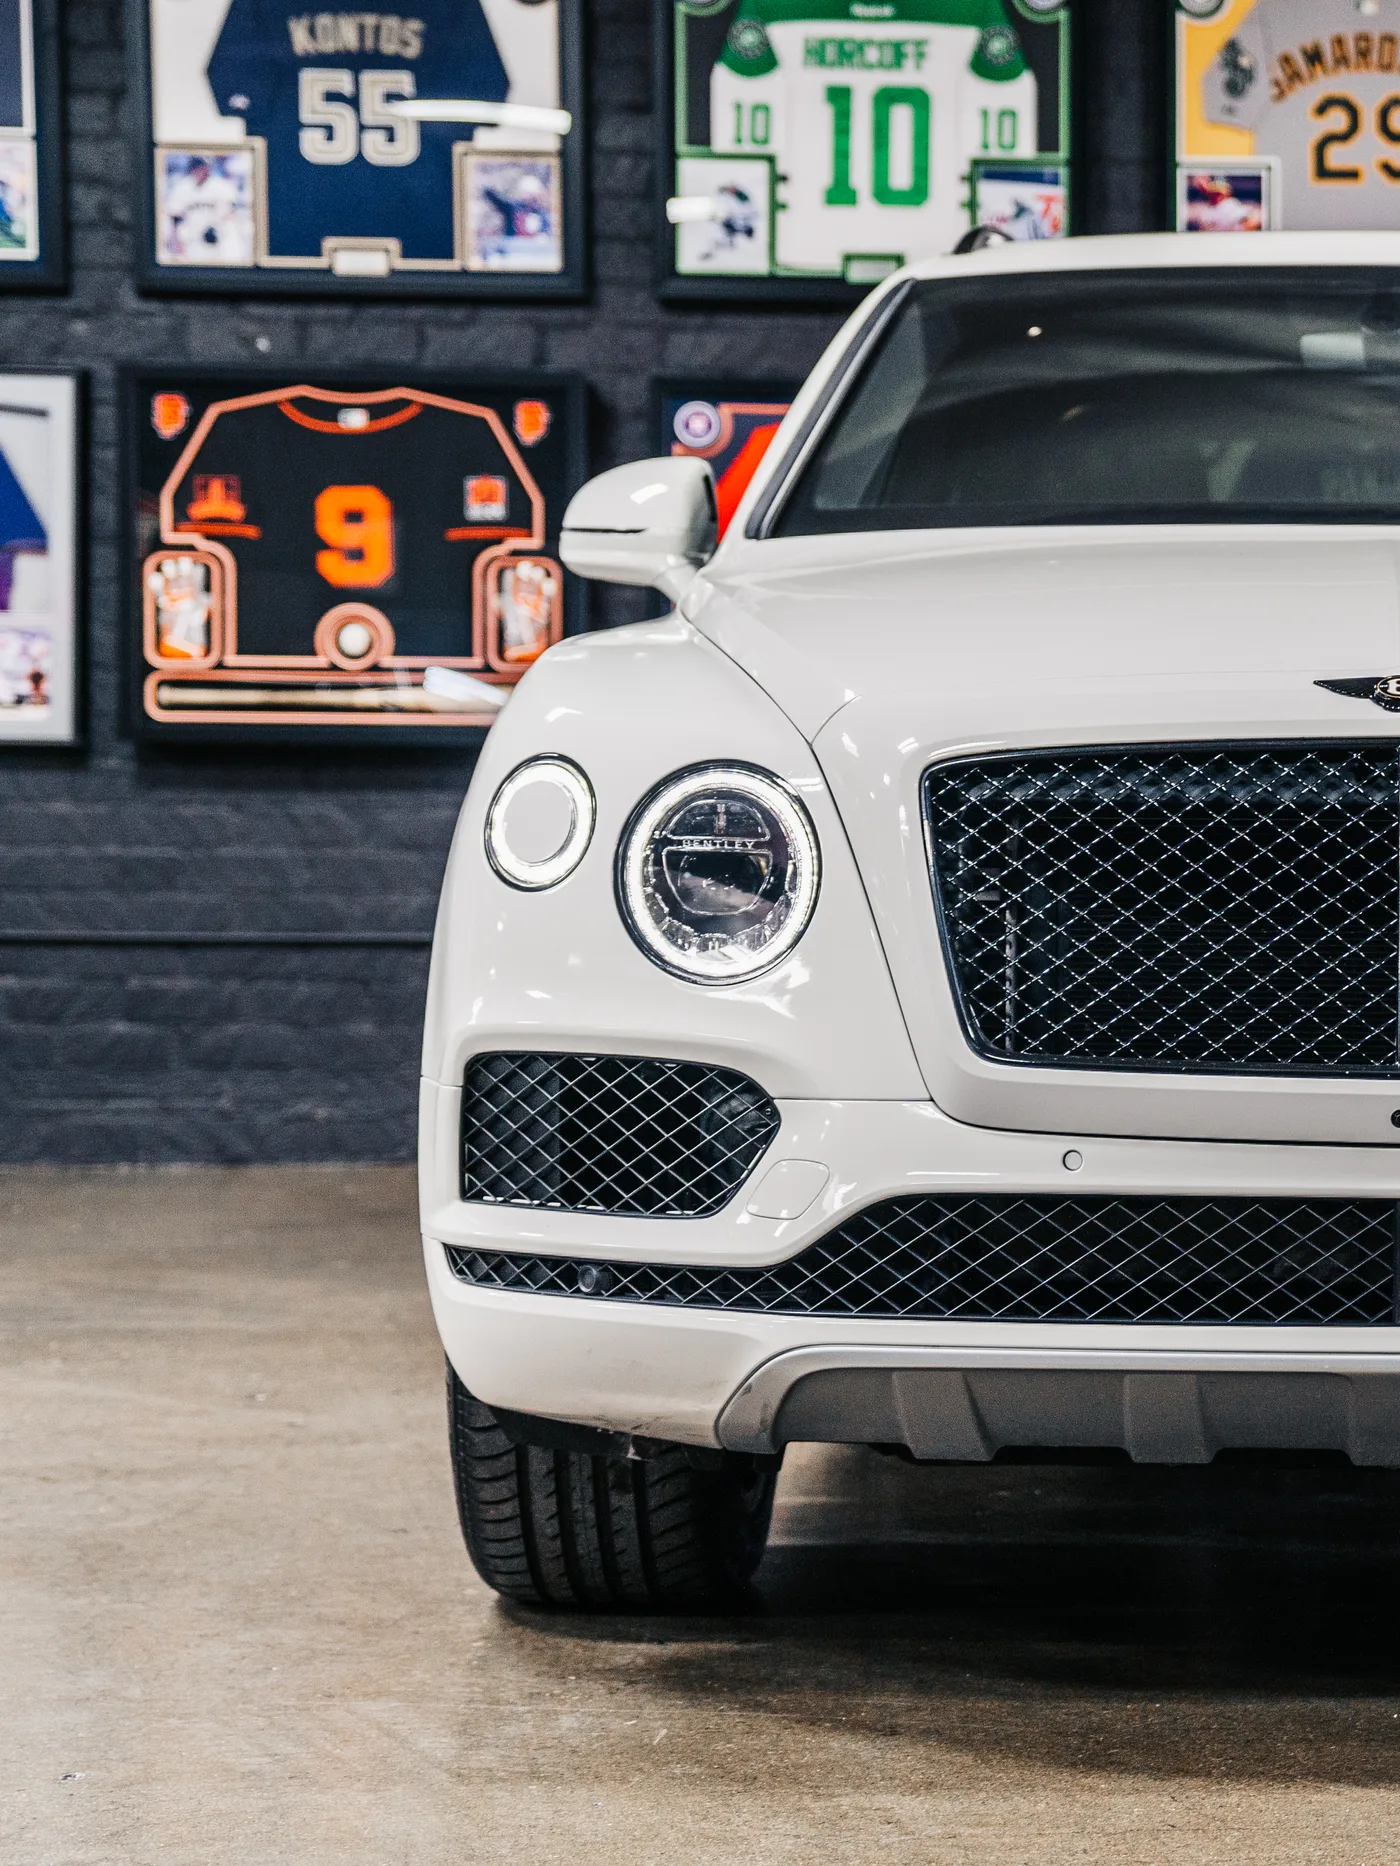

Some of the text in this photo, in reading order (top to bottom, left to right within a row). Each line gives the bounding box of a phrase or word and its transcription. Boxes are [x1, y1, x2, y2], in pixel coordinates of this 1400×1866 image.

[288, 13, 427, 60] KONTOS
[298, 67, 422, 167] 55
[733, 101, 771, 145] 10
[980, 108, 1018, 151] 10
[824, 85, 932, 206] 10
[313, 484, 396, 588] 9
[682, 839, 755, 850] BENTLEY
